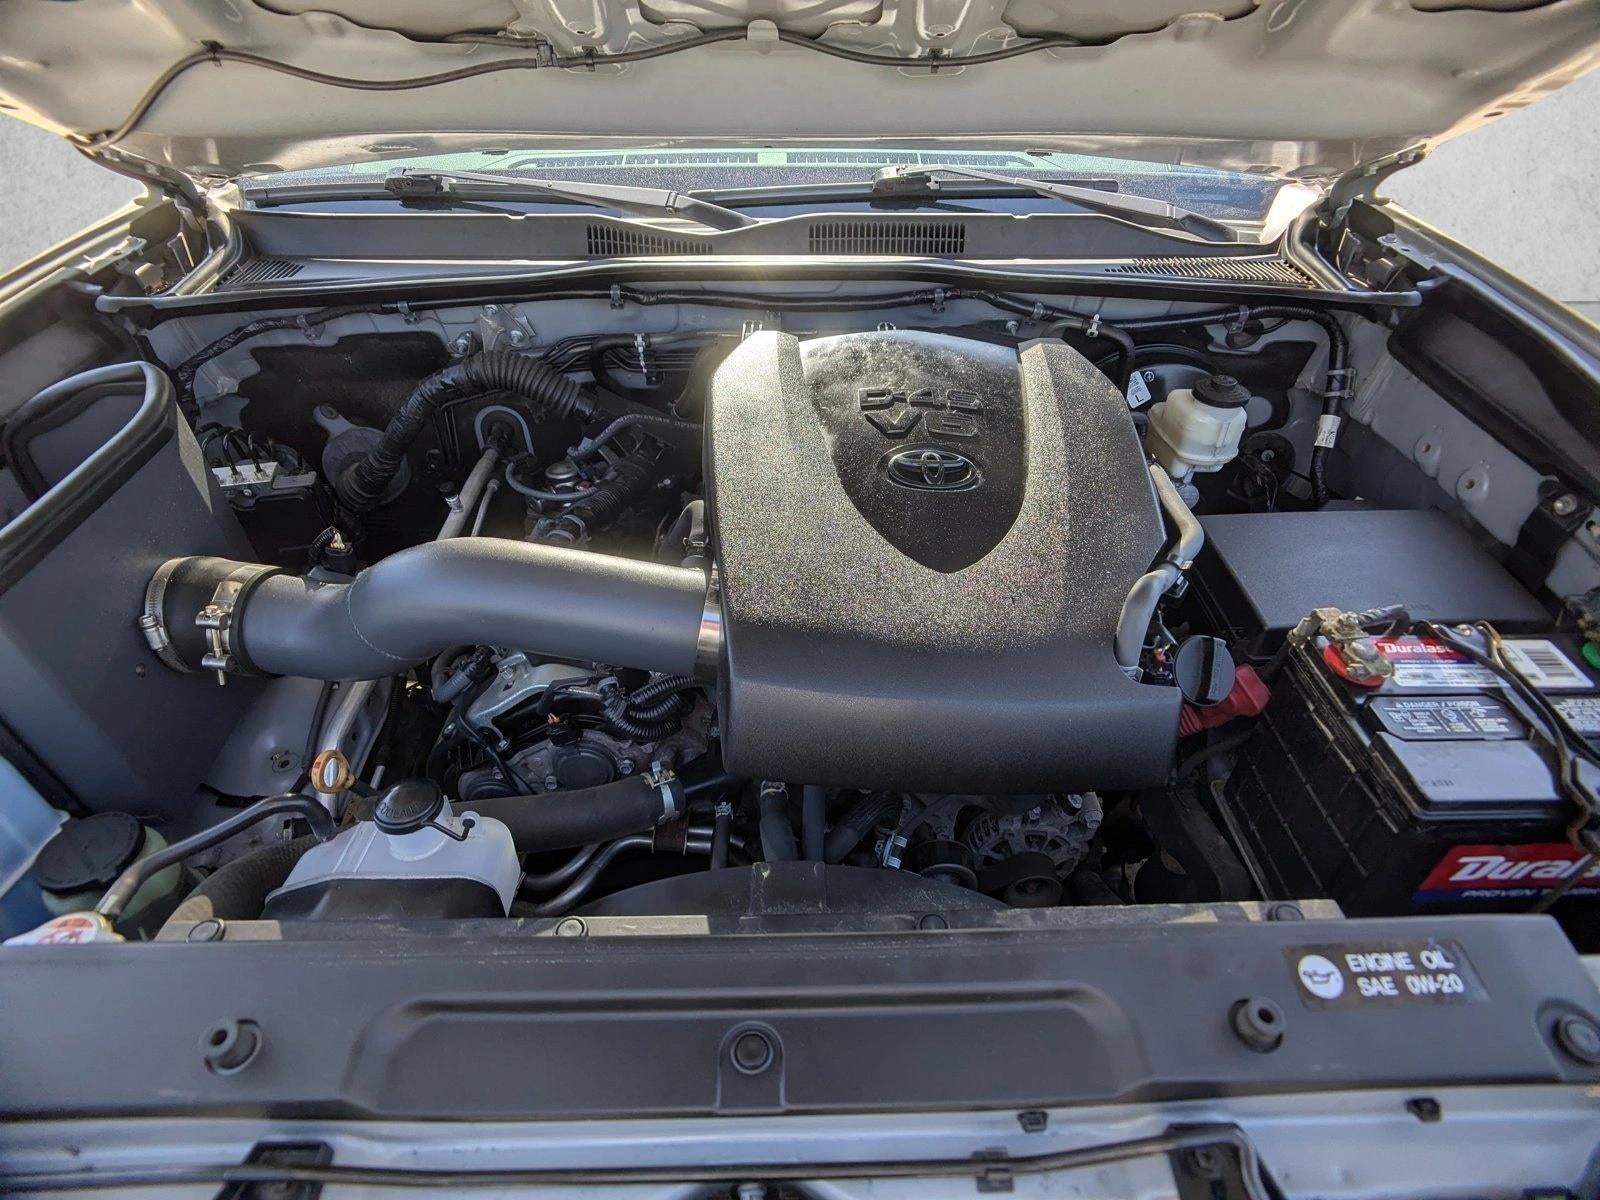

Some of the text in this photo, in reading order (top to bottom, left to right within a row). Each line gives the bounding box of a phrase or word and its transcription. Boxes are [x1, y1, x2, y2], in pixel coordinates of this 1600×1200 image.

[1345, 949, 1455, 973] ENGINE OIL
[1356, 973, 1464, 997] SAE 0W-20
